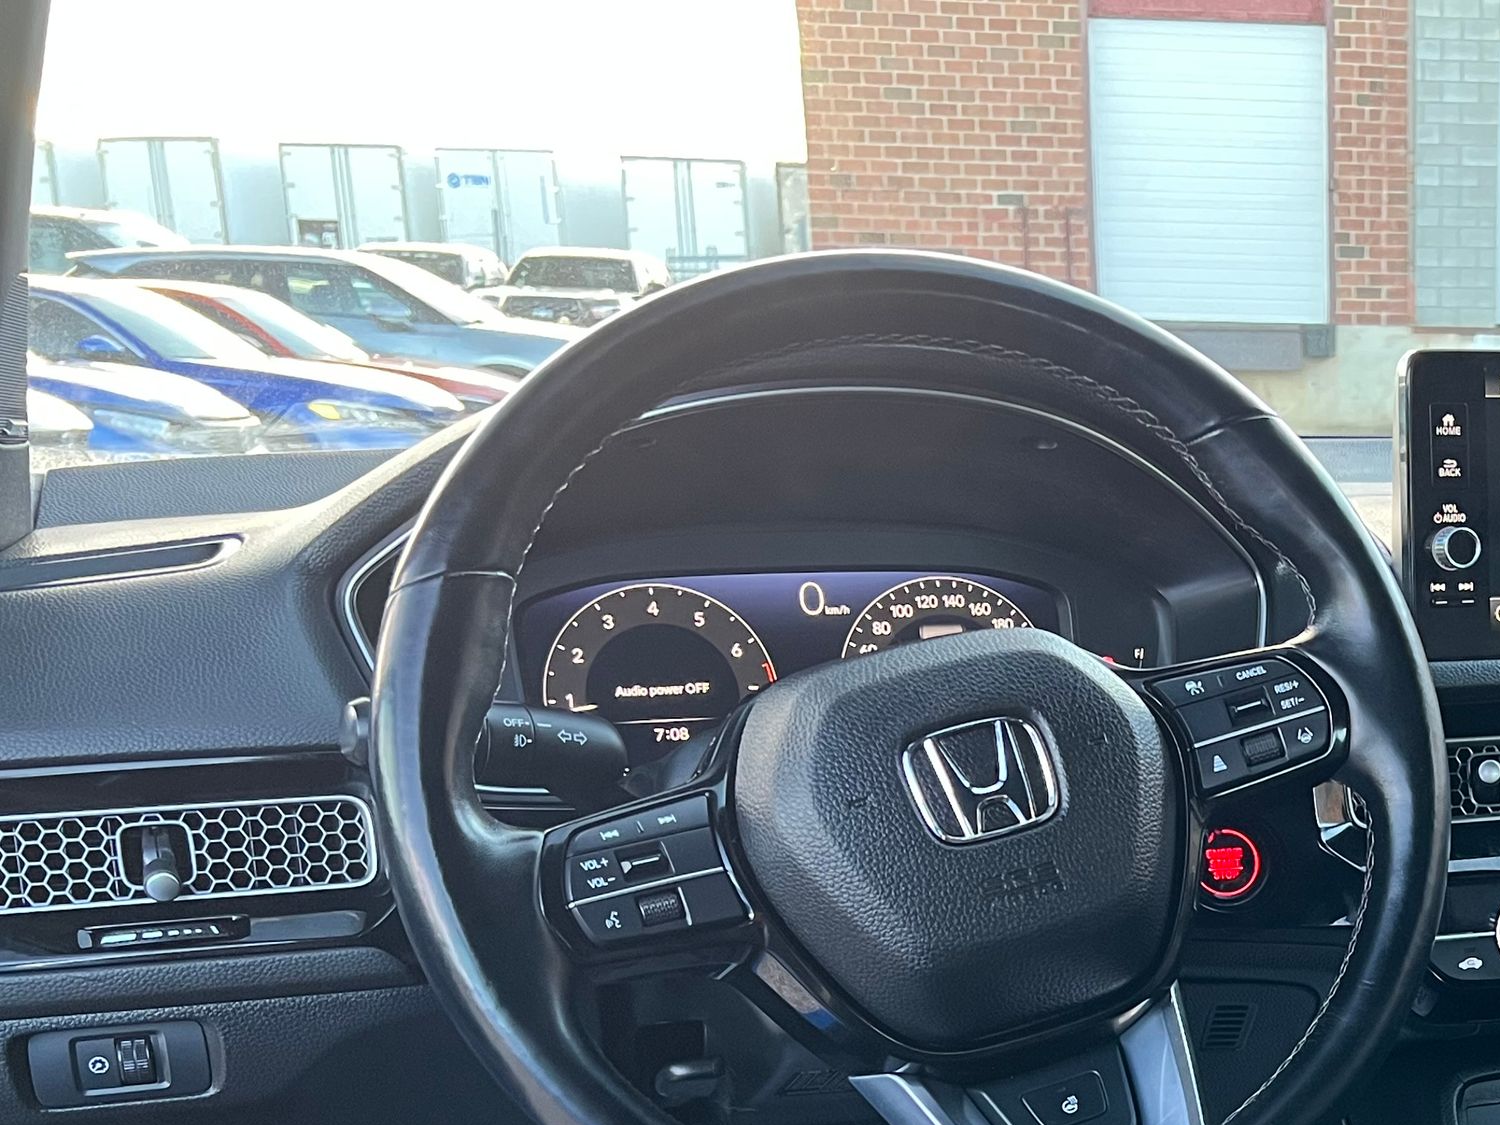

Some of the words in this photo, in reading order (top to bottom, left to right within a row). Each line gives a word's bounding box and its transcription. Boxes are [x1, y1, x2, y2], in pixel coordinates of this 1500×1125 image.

[1436, 426, 1461, 436] HOME
[1438, 468, 1461, 477] BACK
[1442, 504, 1458, 513] VOL
[1443, 513, 1466, 523] AUDIO
[799, 581, 825, 616] 0
[825, 605, 851, 617] km/h
[915, 594, 938, 609] 120
[942, 594, 965, 608] 140
[647, 601, 660, 617] 4
[889, 604, 914, 618] 100
[968, 602, 992, 617] 160
[602, 614, 615, 630] 3
[694, 611, 706, 628] 5
[872, 621, 892, 635] 80
[571, 647, 585, 664] 2
[731, 642, 743, 658] 6
[1236, 666, 1267, 680] CANCEL
[615, 684, 648, 698] Audio
[649, 685, 685, 698] power
[685, 682, 710, 695] OFF
[1274, 679, 1300, 694] RES/+
[503, 717, 525, 728] OFF
[654, 727, 691, 742] 7:08
